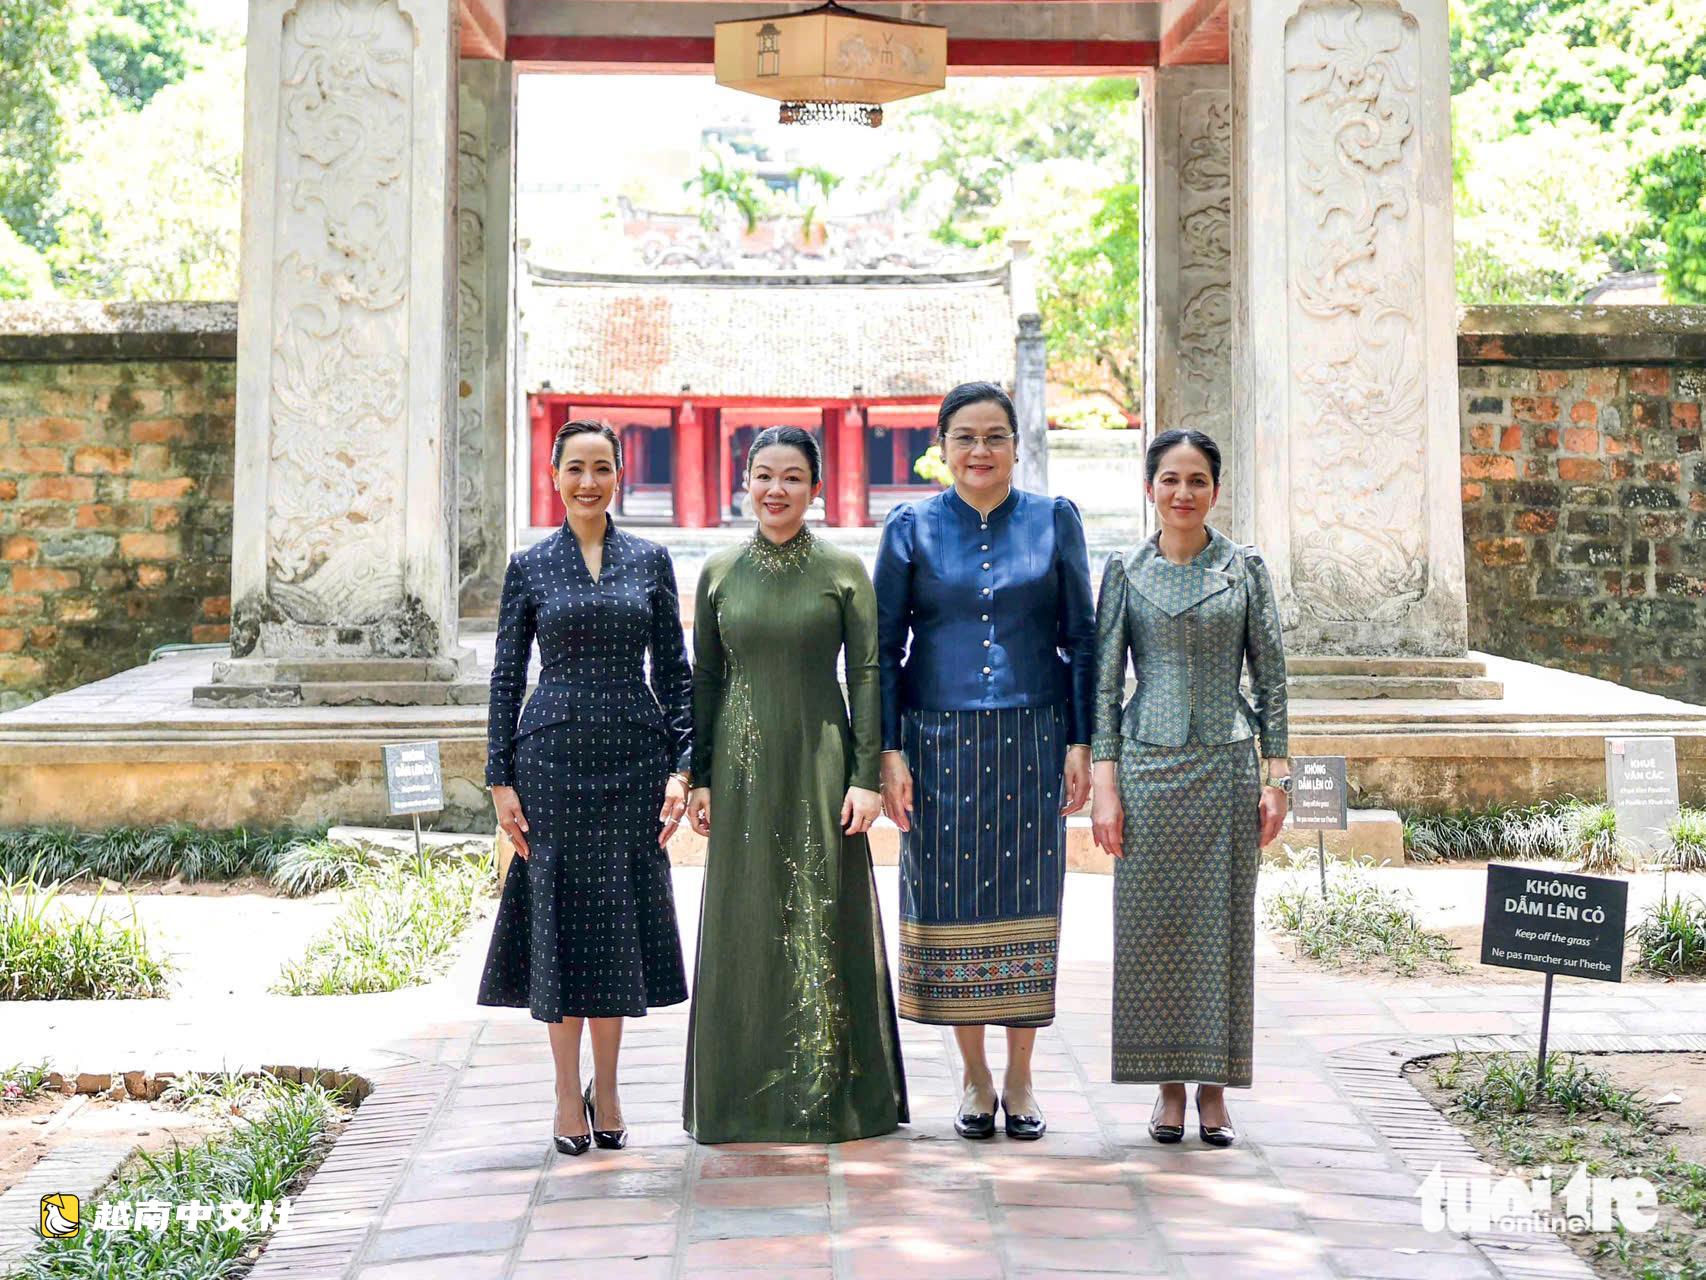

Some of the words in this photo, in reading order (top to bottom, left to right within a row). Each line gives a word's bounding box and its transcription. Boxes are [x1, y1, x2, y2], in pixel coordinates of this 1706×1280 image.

[1526, 879, 1587, 900] KHÔNG
[1504, 895, 1544, 917] DẪM
[1547, 902, 1579, 920] LÊN
[1581, 906, 1606, 924] CỎ
[1515, 928, 1537, 941] Keep
[1537, 931, 1552, 941] off
[1551, 933, 1567, 943] the
[1566, 937, 1592, 946] grass
[1491, 947, 1505, 957] Ne
[1506, 950, 1522, 960] pas
[1524, 953, 1562, 965] marcher
[1563, 958, 1578, 967] sur
[1579, 958, 1612, 972] l'herbe
